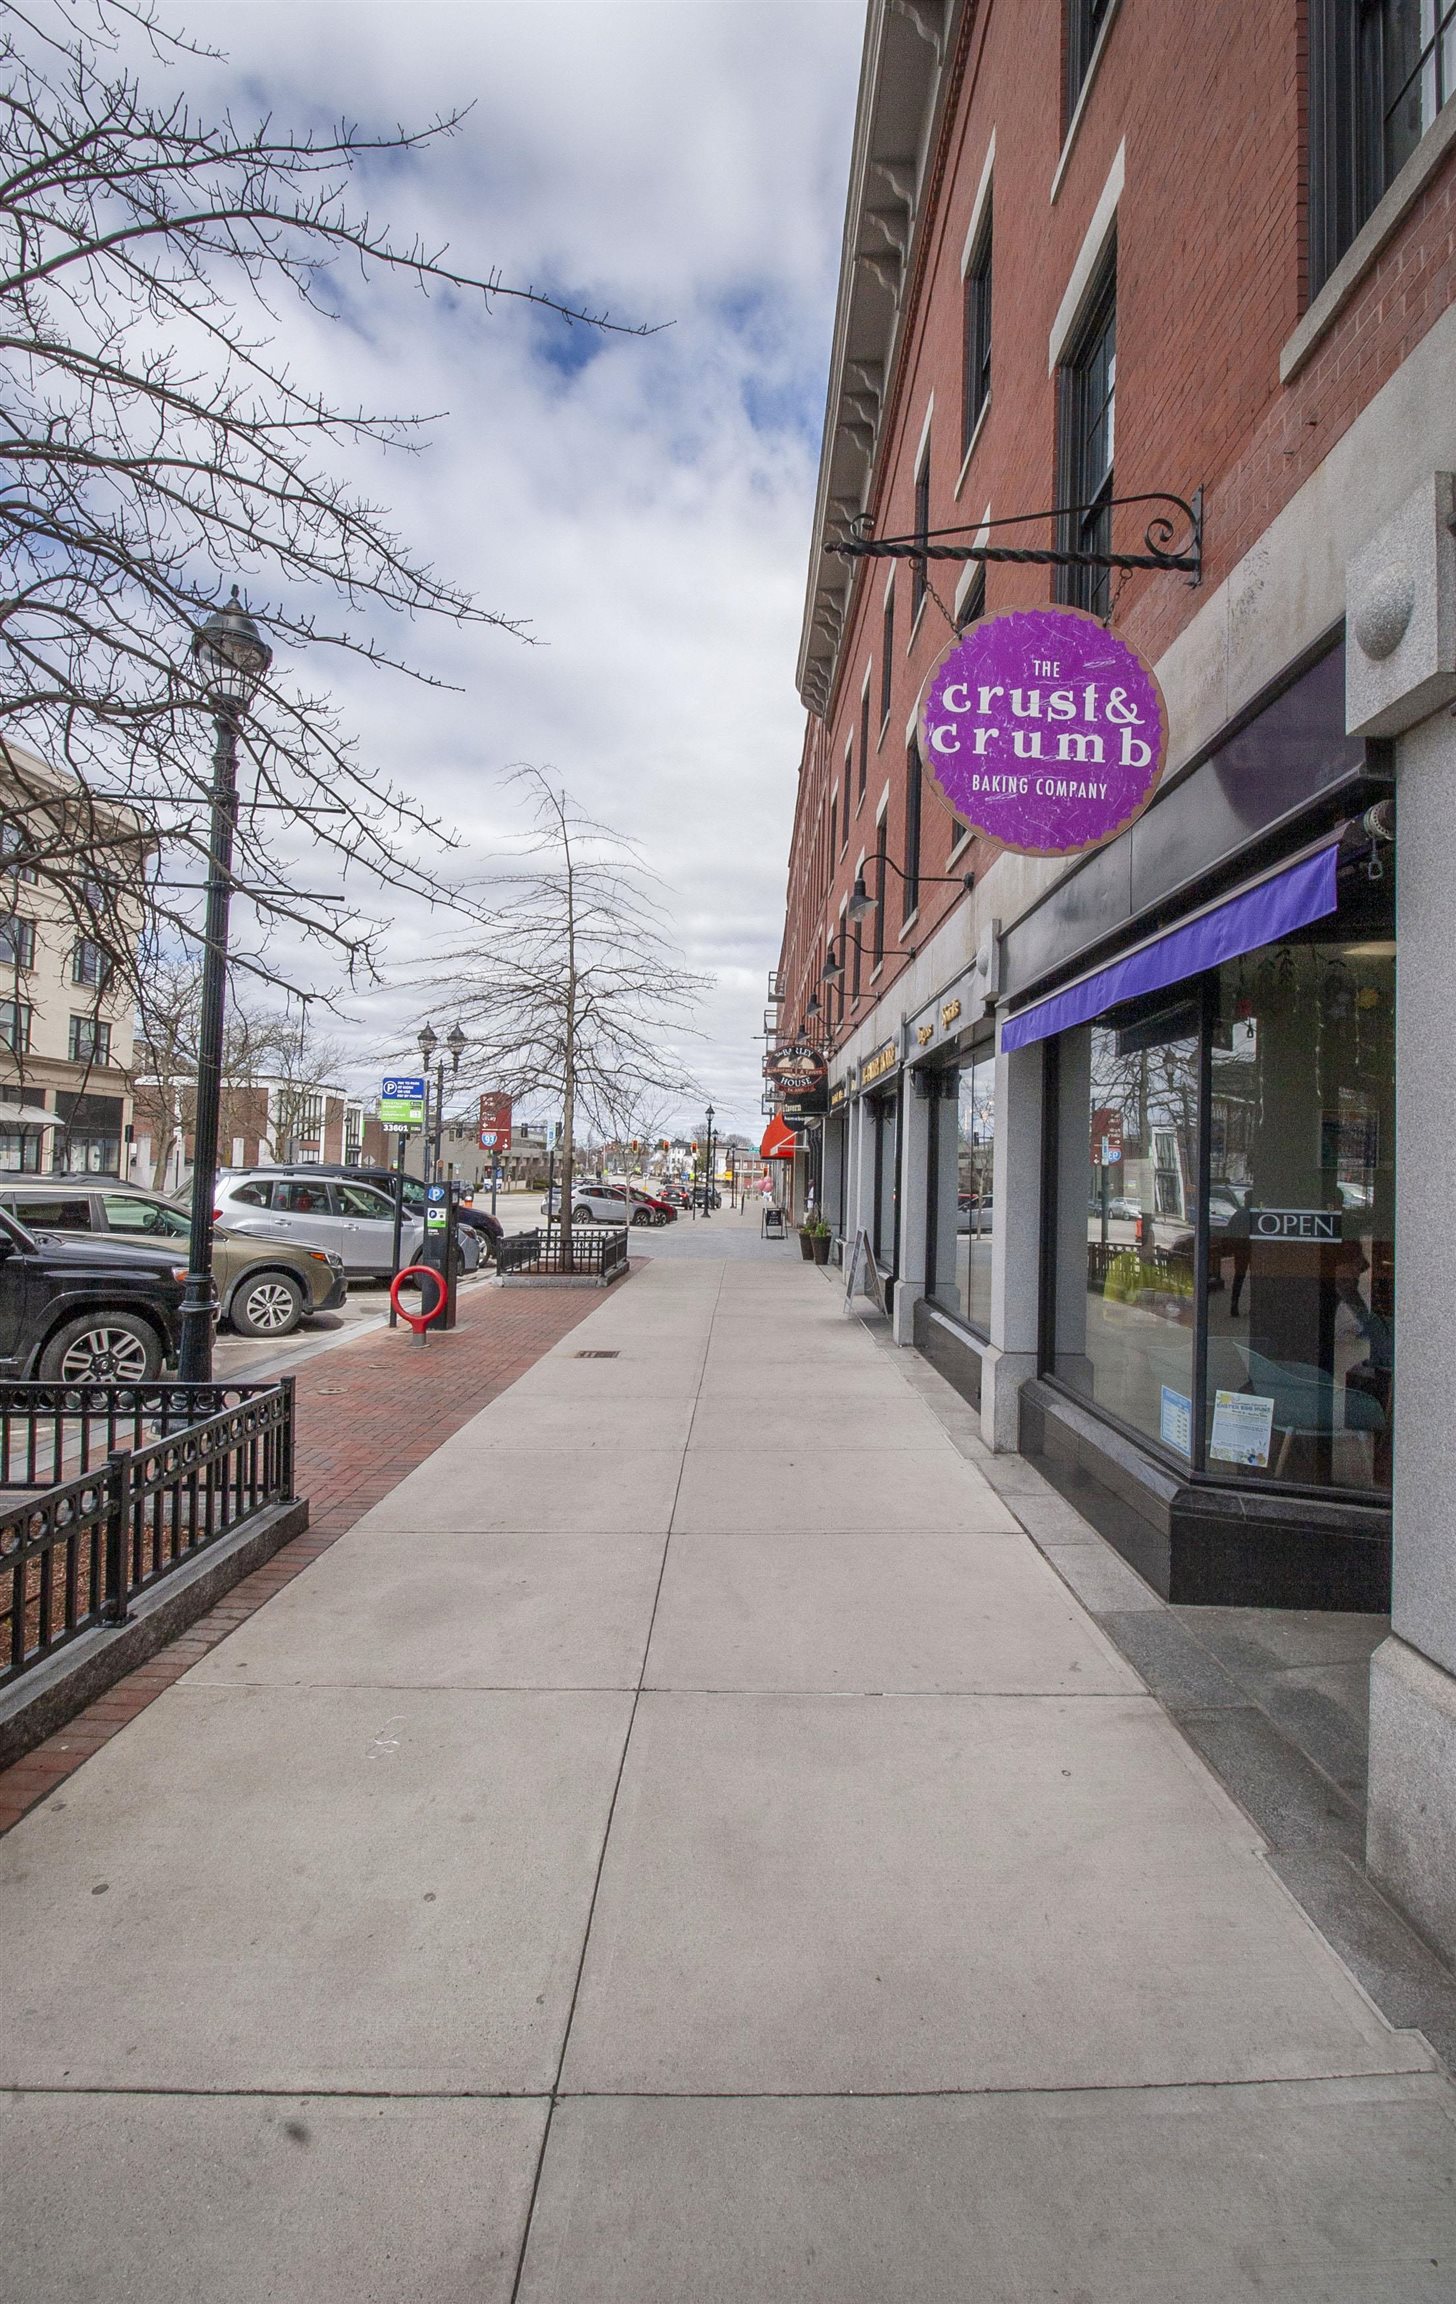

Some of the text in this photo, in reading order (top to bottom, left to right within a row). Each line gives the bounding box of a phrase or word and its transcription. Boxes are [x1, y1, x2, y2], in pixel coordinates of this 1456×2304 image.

[1033, 660, 1060, 678] THE
[930, 723, 1152, 768] crumb
[972, 775, 1108, 800] BAKING COMPANY
[780, 1076, 812, 1087] HOUSE
[484, 1135, 494, 1144] 93
[1258, 1214, 1334, 1237] OPEN
